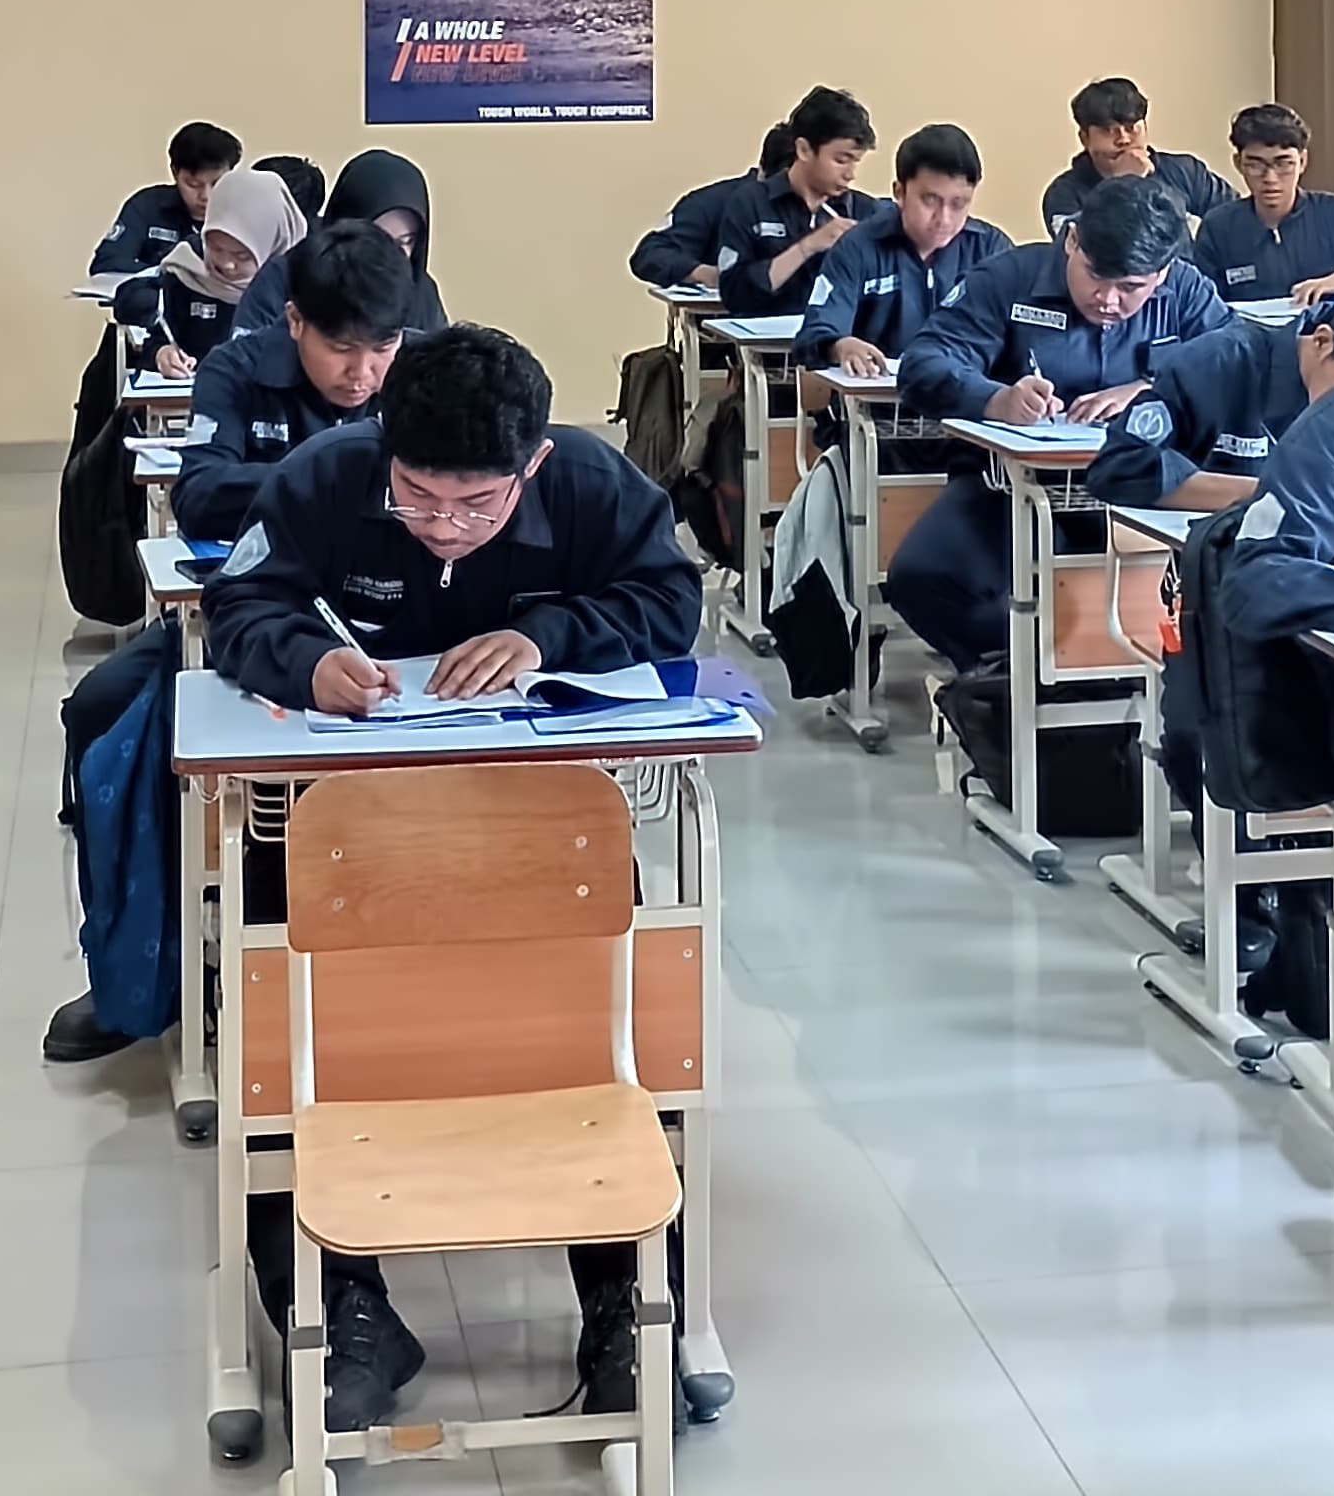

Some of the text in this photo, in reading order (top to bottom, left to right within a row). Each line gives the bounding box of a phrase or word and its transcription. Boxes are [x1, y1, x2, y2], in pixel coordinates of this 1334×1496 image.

[414, 20, 505, 40] A WHOLE
[415, 43, 527, 63] NEW LEVEL
